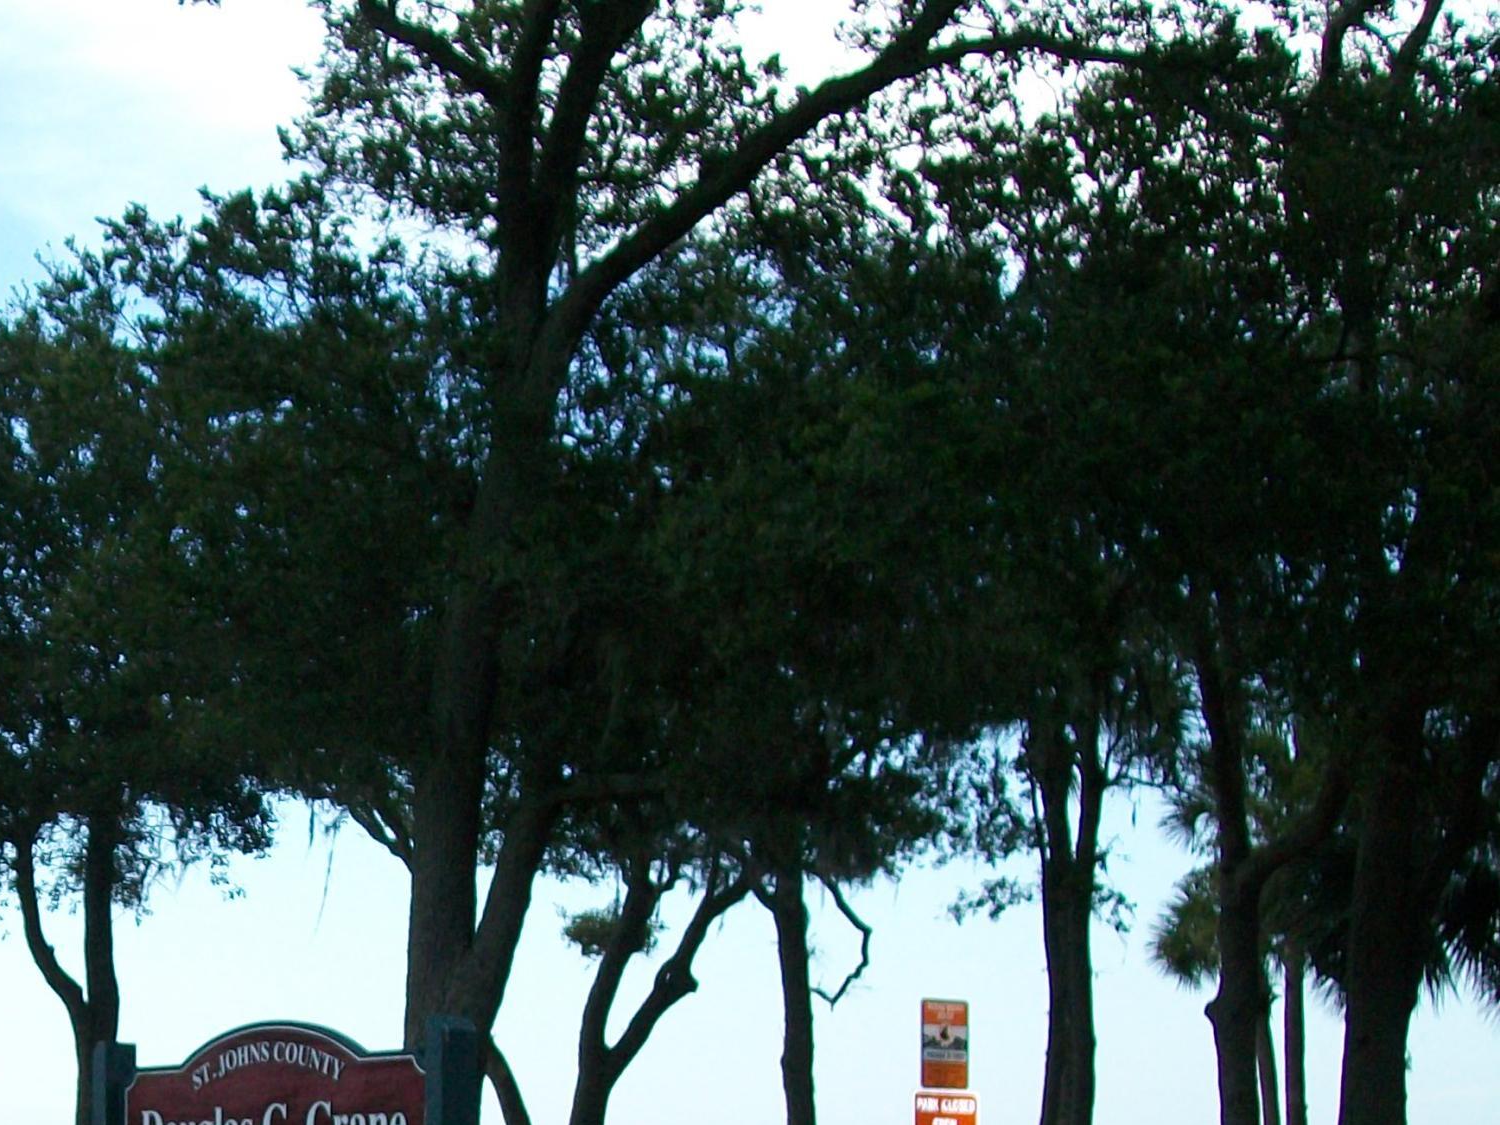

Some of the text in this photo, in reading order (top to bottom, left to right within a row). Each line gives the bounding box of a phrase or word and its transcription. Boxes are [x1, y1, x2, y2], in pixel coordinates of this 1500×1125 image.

[191, 1040, 346, 1091] ST. JOHNS COUNTY
